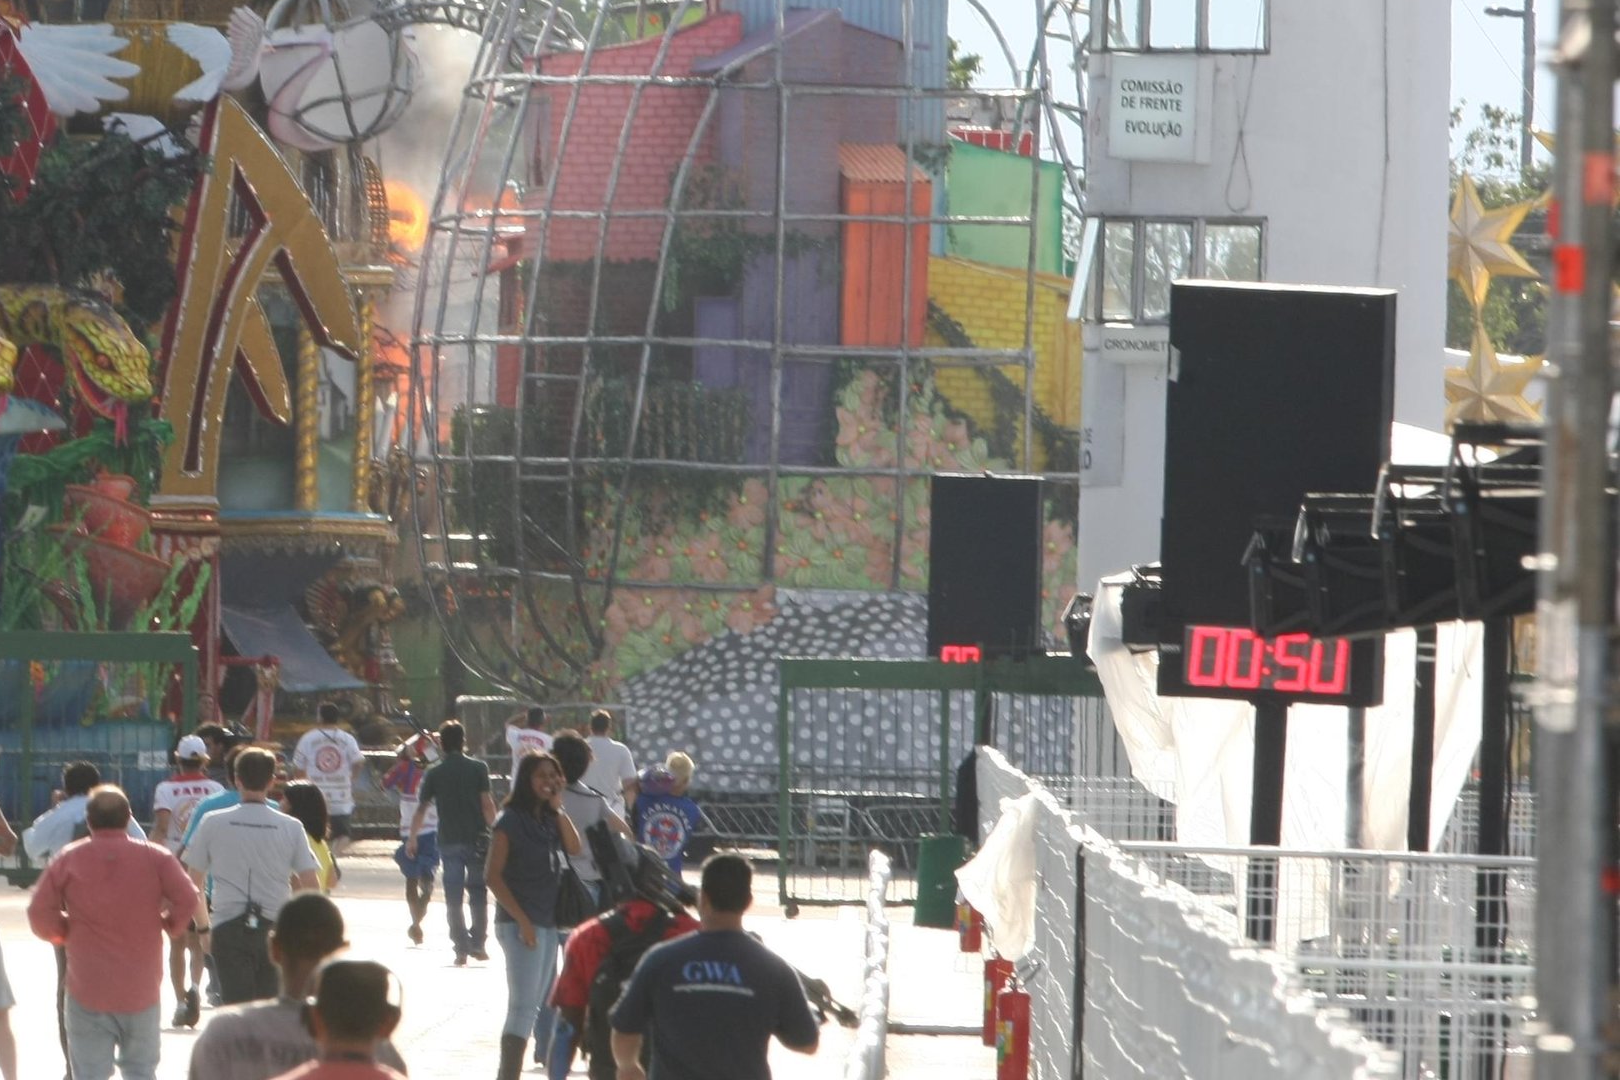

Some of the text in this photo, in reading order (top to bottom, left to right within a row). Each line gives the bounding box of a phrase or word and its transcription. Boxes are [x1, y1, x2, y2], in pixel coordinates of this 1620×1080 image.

[1120, 78, 1183, 95] COMISSÃO
[1120, 96, 1182, 112] DE FRENTE
[1125, 120, 1182, 139] EVOLUÇÃO
[1188, 626, 1349, 694] 00:50
[682, 961, 743, 985] GWA
